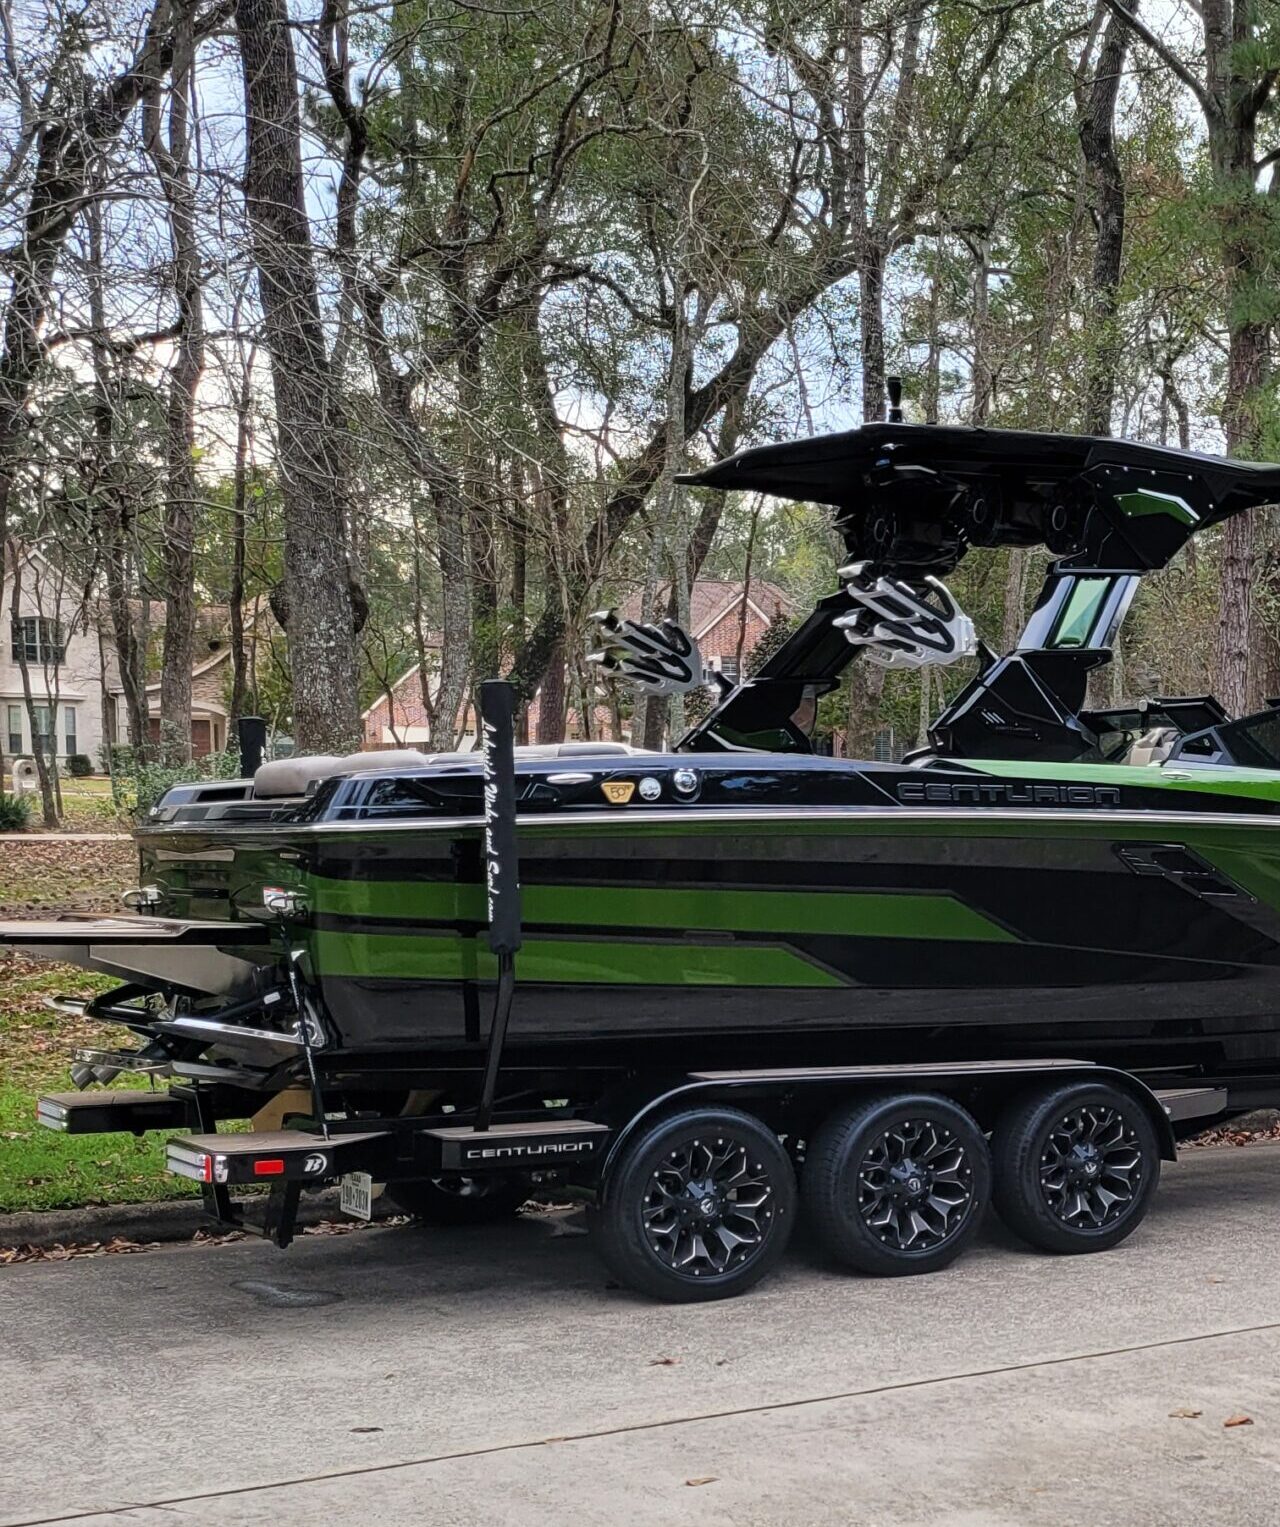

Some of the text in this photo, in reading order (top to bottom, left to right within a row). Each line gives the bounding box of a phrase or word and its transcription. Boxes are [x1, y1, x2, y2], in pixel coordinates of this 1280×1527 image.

[897, 782, 1120, 803] CENTURION
[485, 827, 499, 855] and
[467, 1141, 593, 1159] CENTURION
